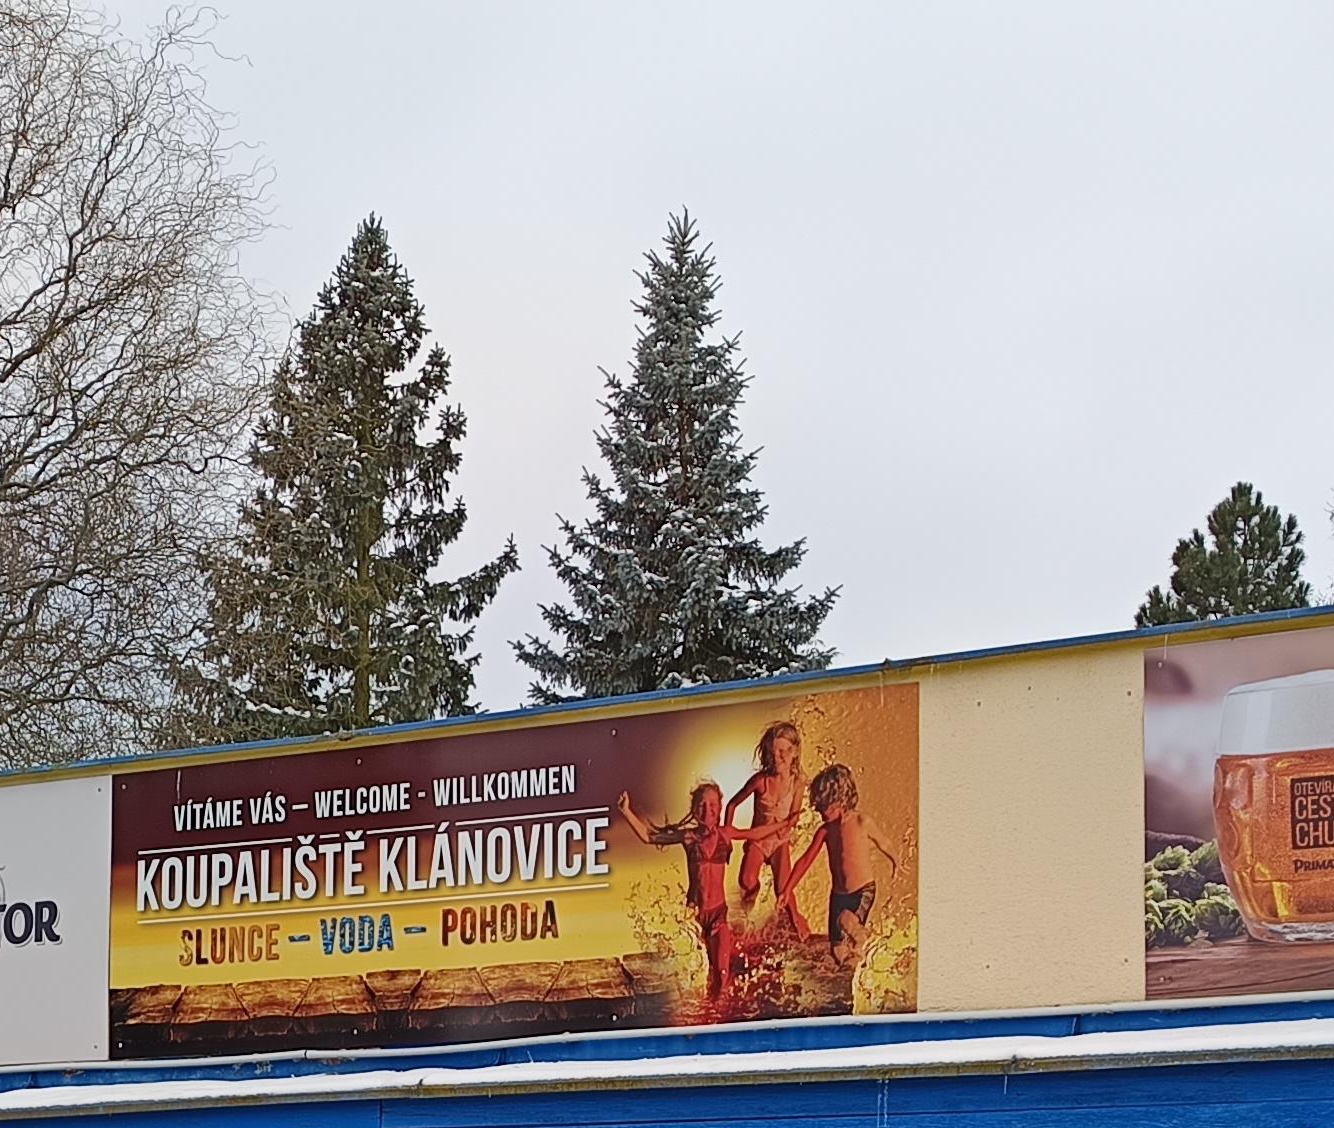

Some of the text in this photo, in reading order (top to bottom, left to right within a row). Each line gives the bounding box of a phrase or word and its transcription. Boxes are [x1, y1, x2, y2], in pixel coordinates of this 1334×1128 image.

[173, 796, 243, 832] VÍTÁME
[249, 791, 286, 825] VÁS
[315, 783, 411, 819] WELCOME
[433, 764, 575, 807] WILLKOMMEN
[136, 817, 610, 912] KOUPALIŠTĚ KLÁNOVICE
[179, 923, 281, 967] SLUNCE
[320, 913, 395, 956] VODA
[441, 900, 559, 947] POHODA
